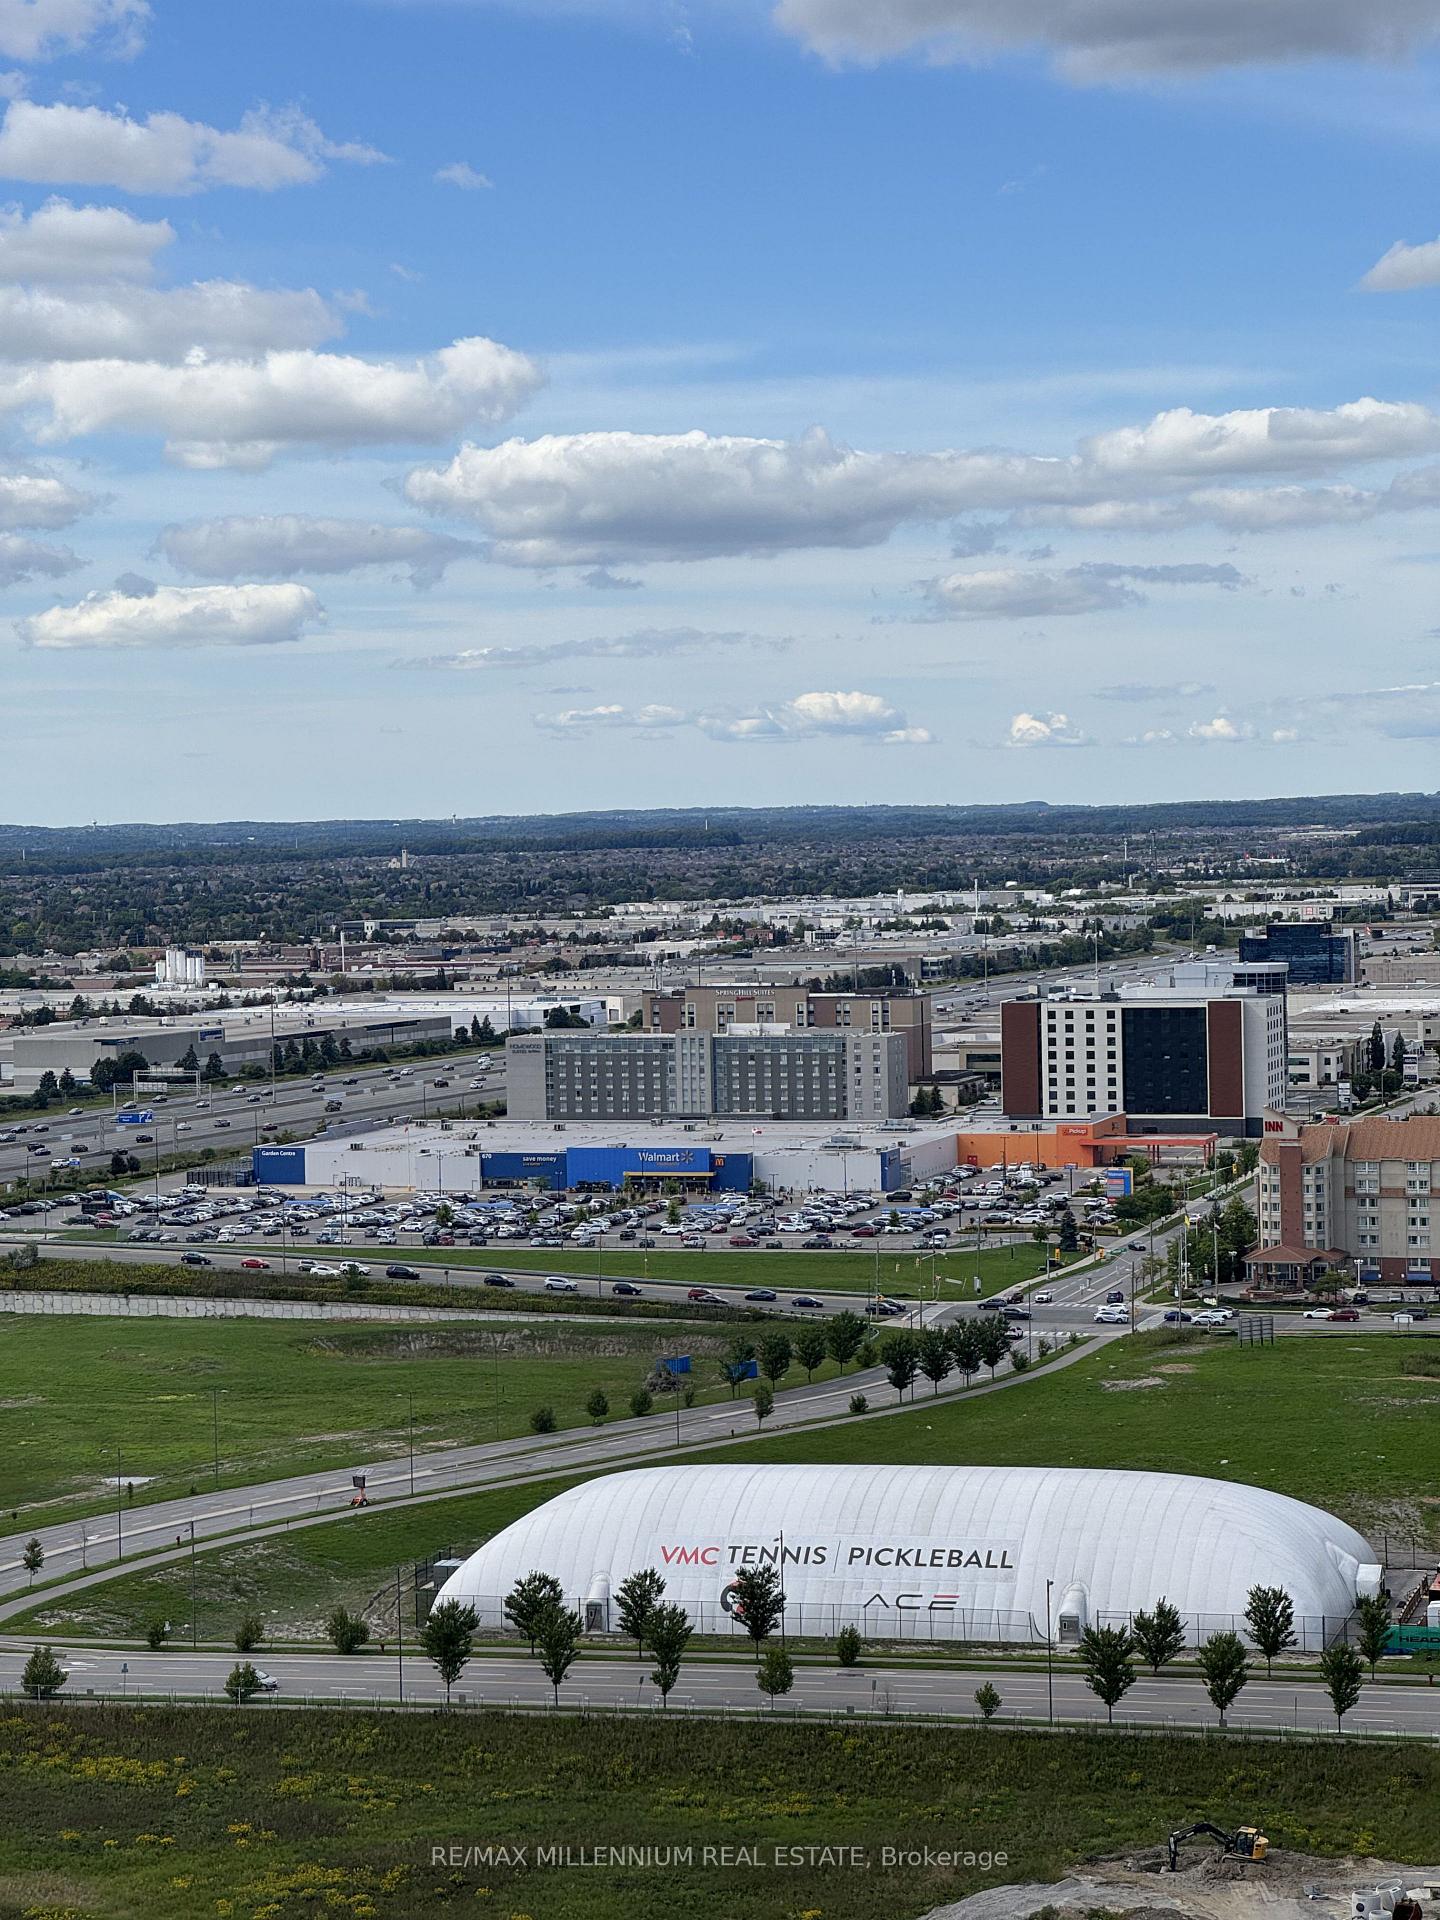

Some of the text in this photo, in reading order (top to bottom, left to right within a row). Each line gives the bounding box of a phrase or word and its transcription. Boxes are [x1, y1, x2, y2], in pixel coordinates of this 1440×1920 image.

[1264, 1121, 1283, 1132] INN
[638, 1152, 680, 1162] Walmart
[661, 1545, 1014, 1569] VMC TENNIS PICKLEBALL
[863, 1593, 960, 1610] ACE
